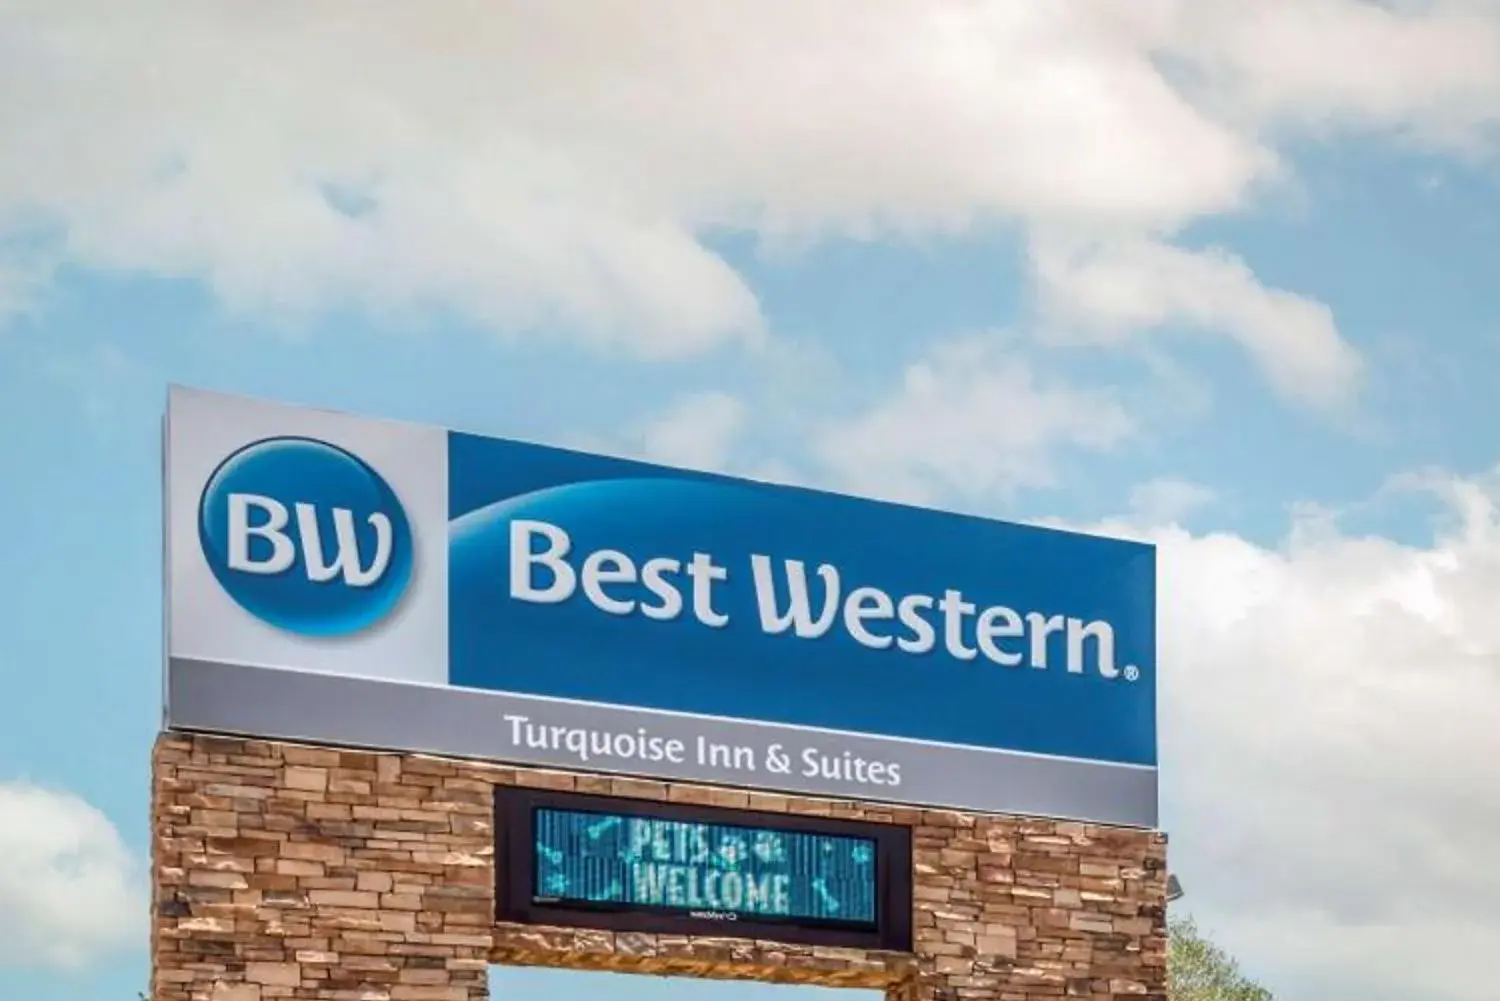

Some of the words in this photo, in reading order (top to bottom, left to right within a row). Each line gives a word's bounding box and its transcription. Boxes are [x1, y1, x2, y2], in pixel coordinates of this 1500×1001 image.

[226, 492, 392, 588] BW
[508, 518, 729, 628] Best
[749, 553, 1120, 679] Western
[504, 714, 686, 768] Turquoise
[697, 735, 756, 773] Inn
[765, 745, 791, 774] &
[801, 746, 902, 787] Suites
[631, 817, 710, 862] PETS
[634, 863, 790, 914] WELCOME
